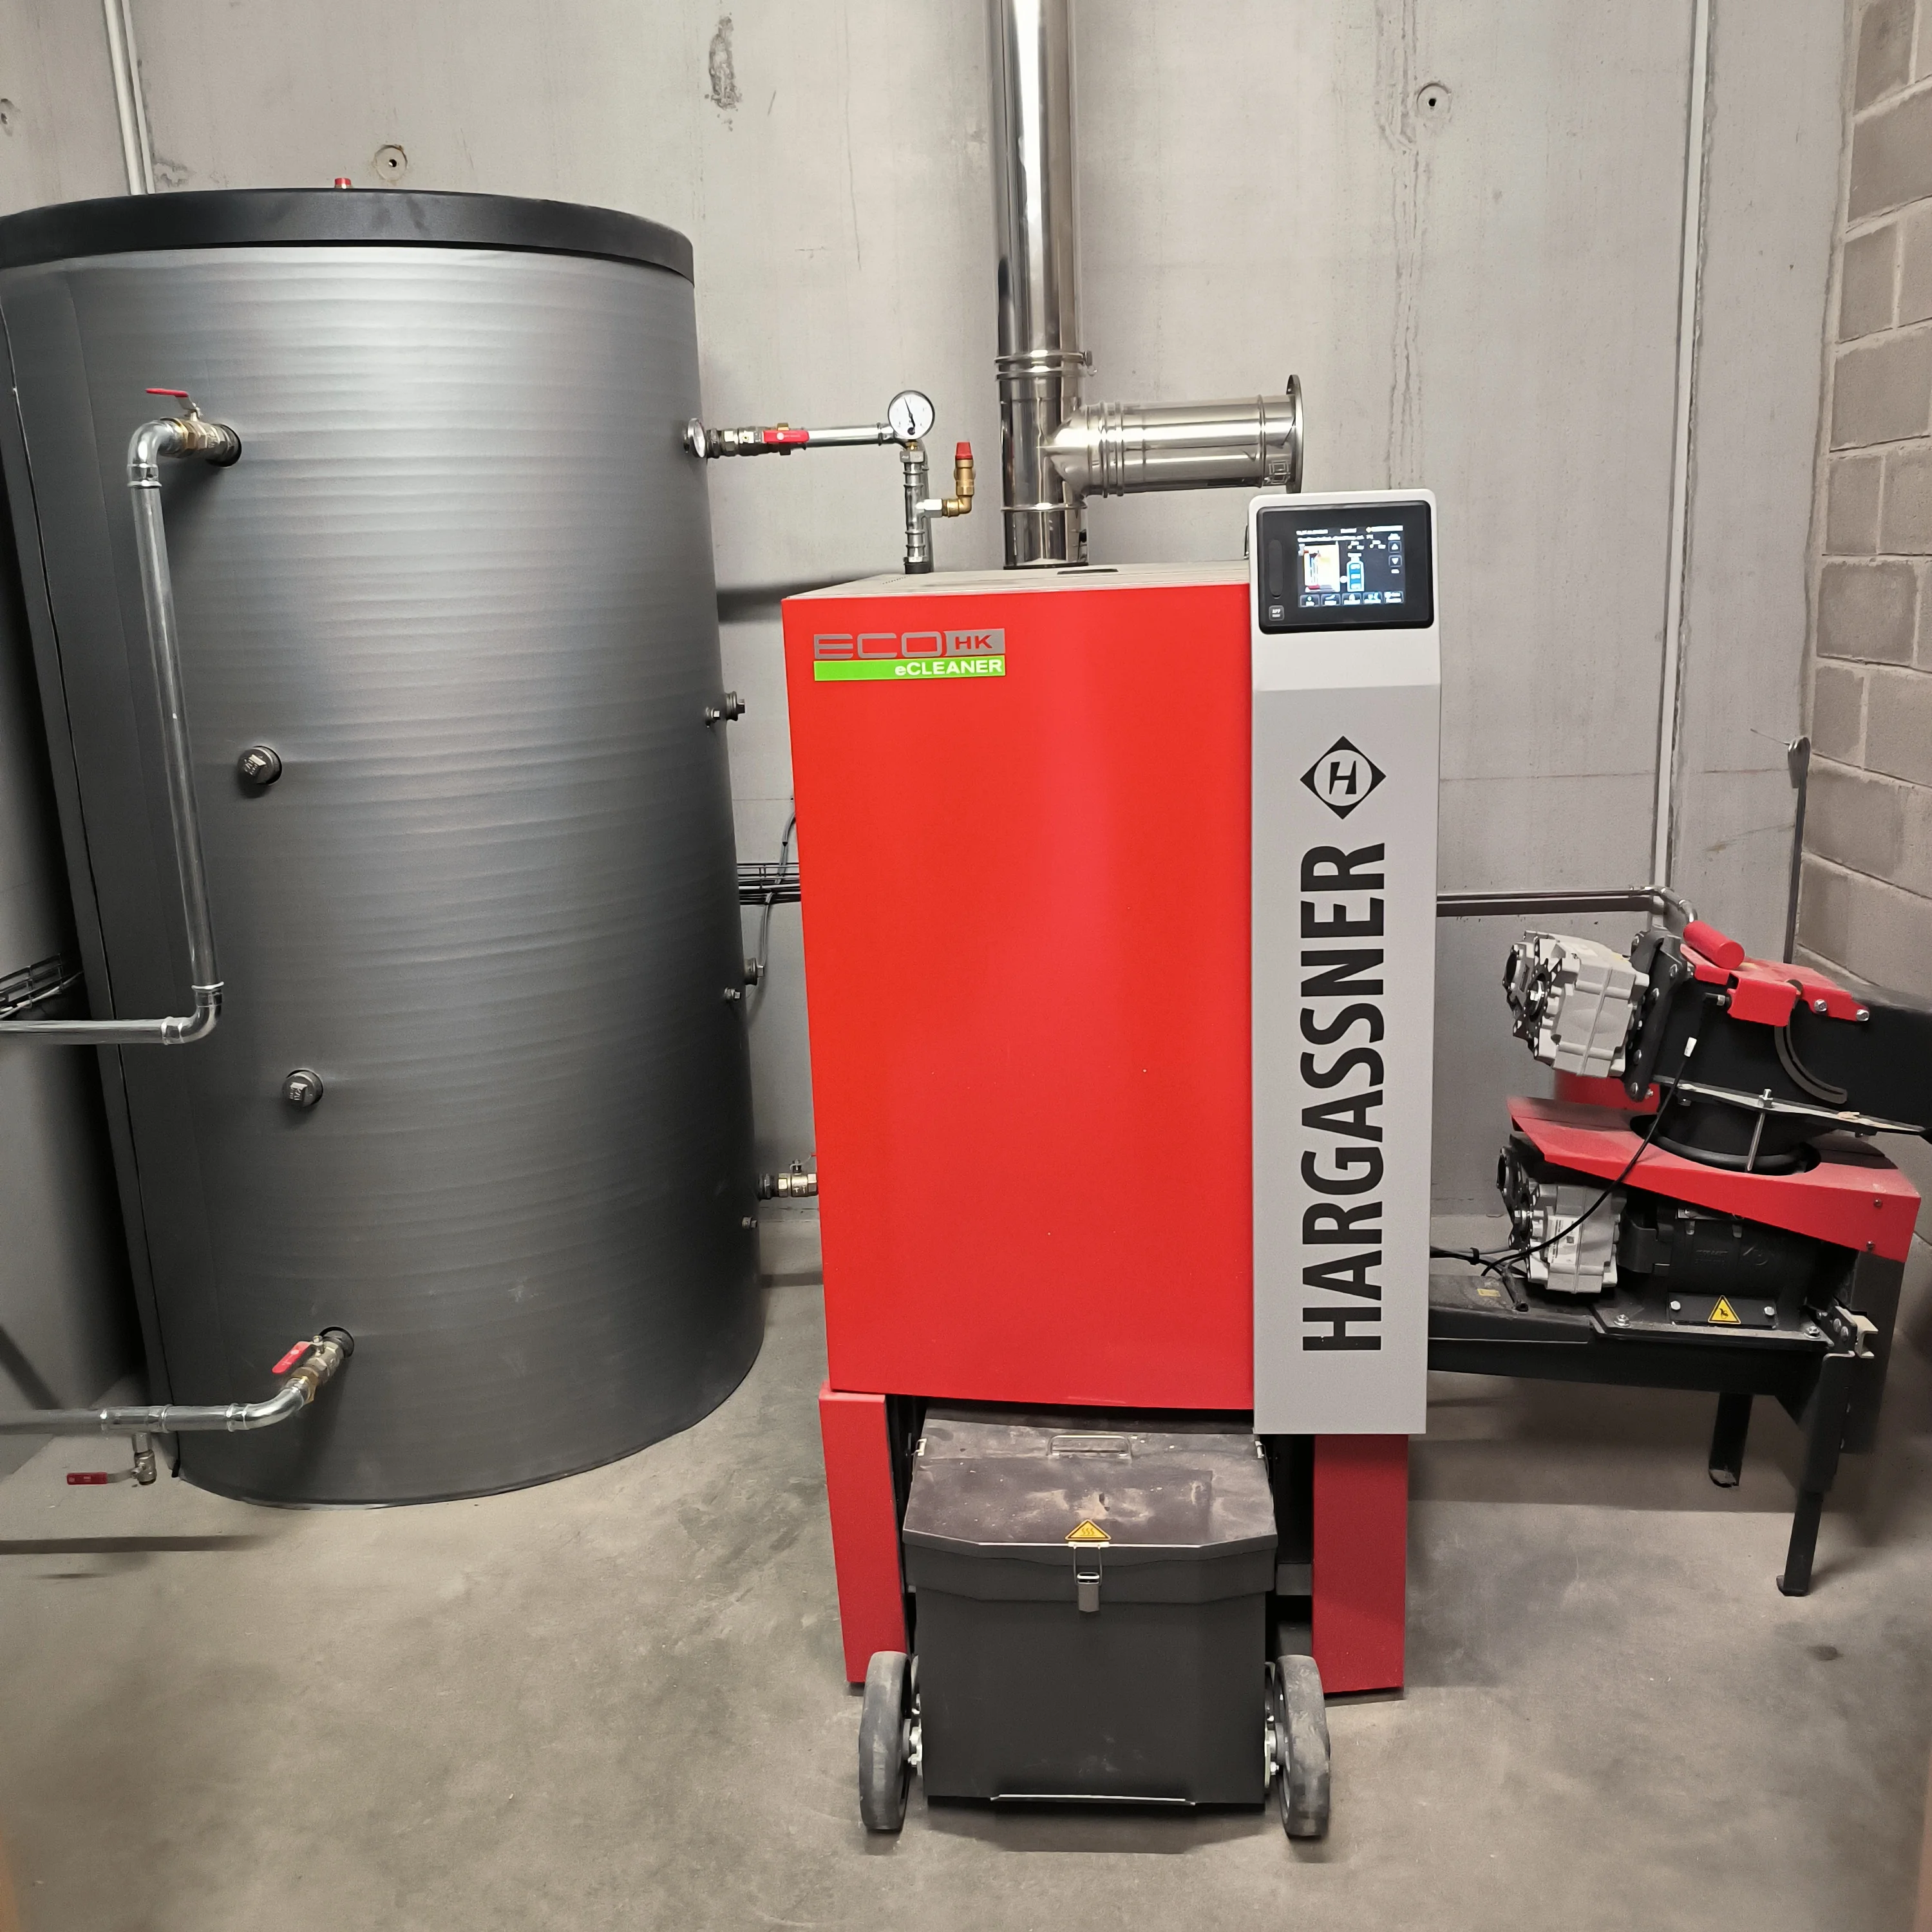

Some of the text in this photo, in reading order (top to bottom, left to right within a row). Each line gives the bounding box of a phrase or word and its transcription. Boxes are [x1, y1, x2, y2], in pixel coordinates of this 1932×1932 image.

[814, 631, 992, 659] ECO HK
[895, 659, 1002, 676] eCLEANER
[1329, 761, 1356, 794] H
[1300, 843, 1385, 1350] HARGASSNER
